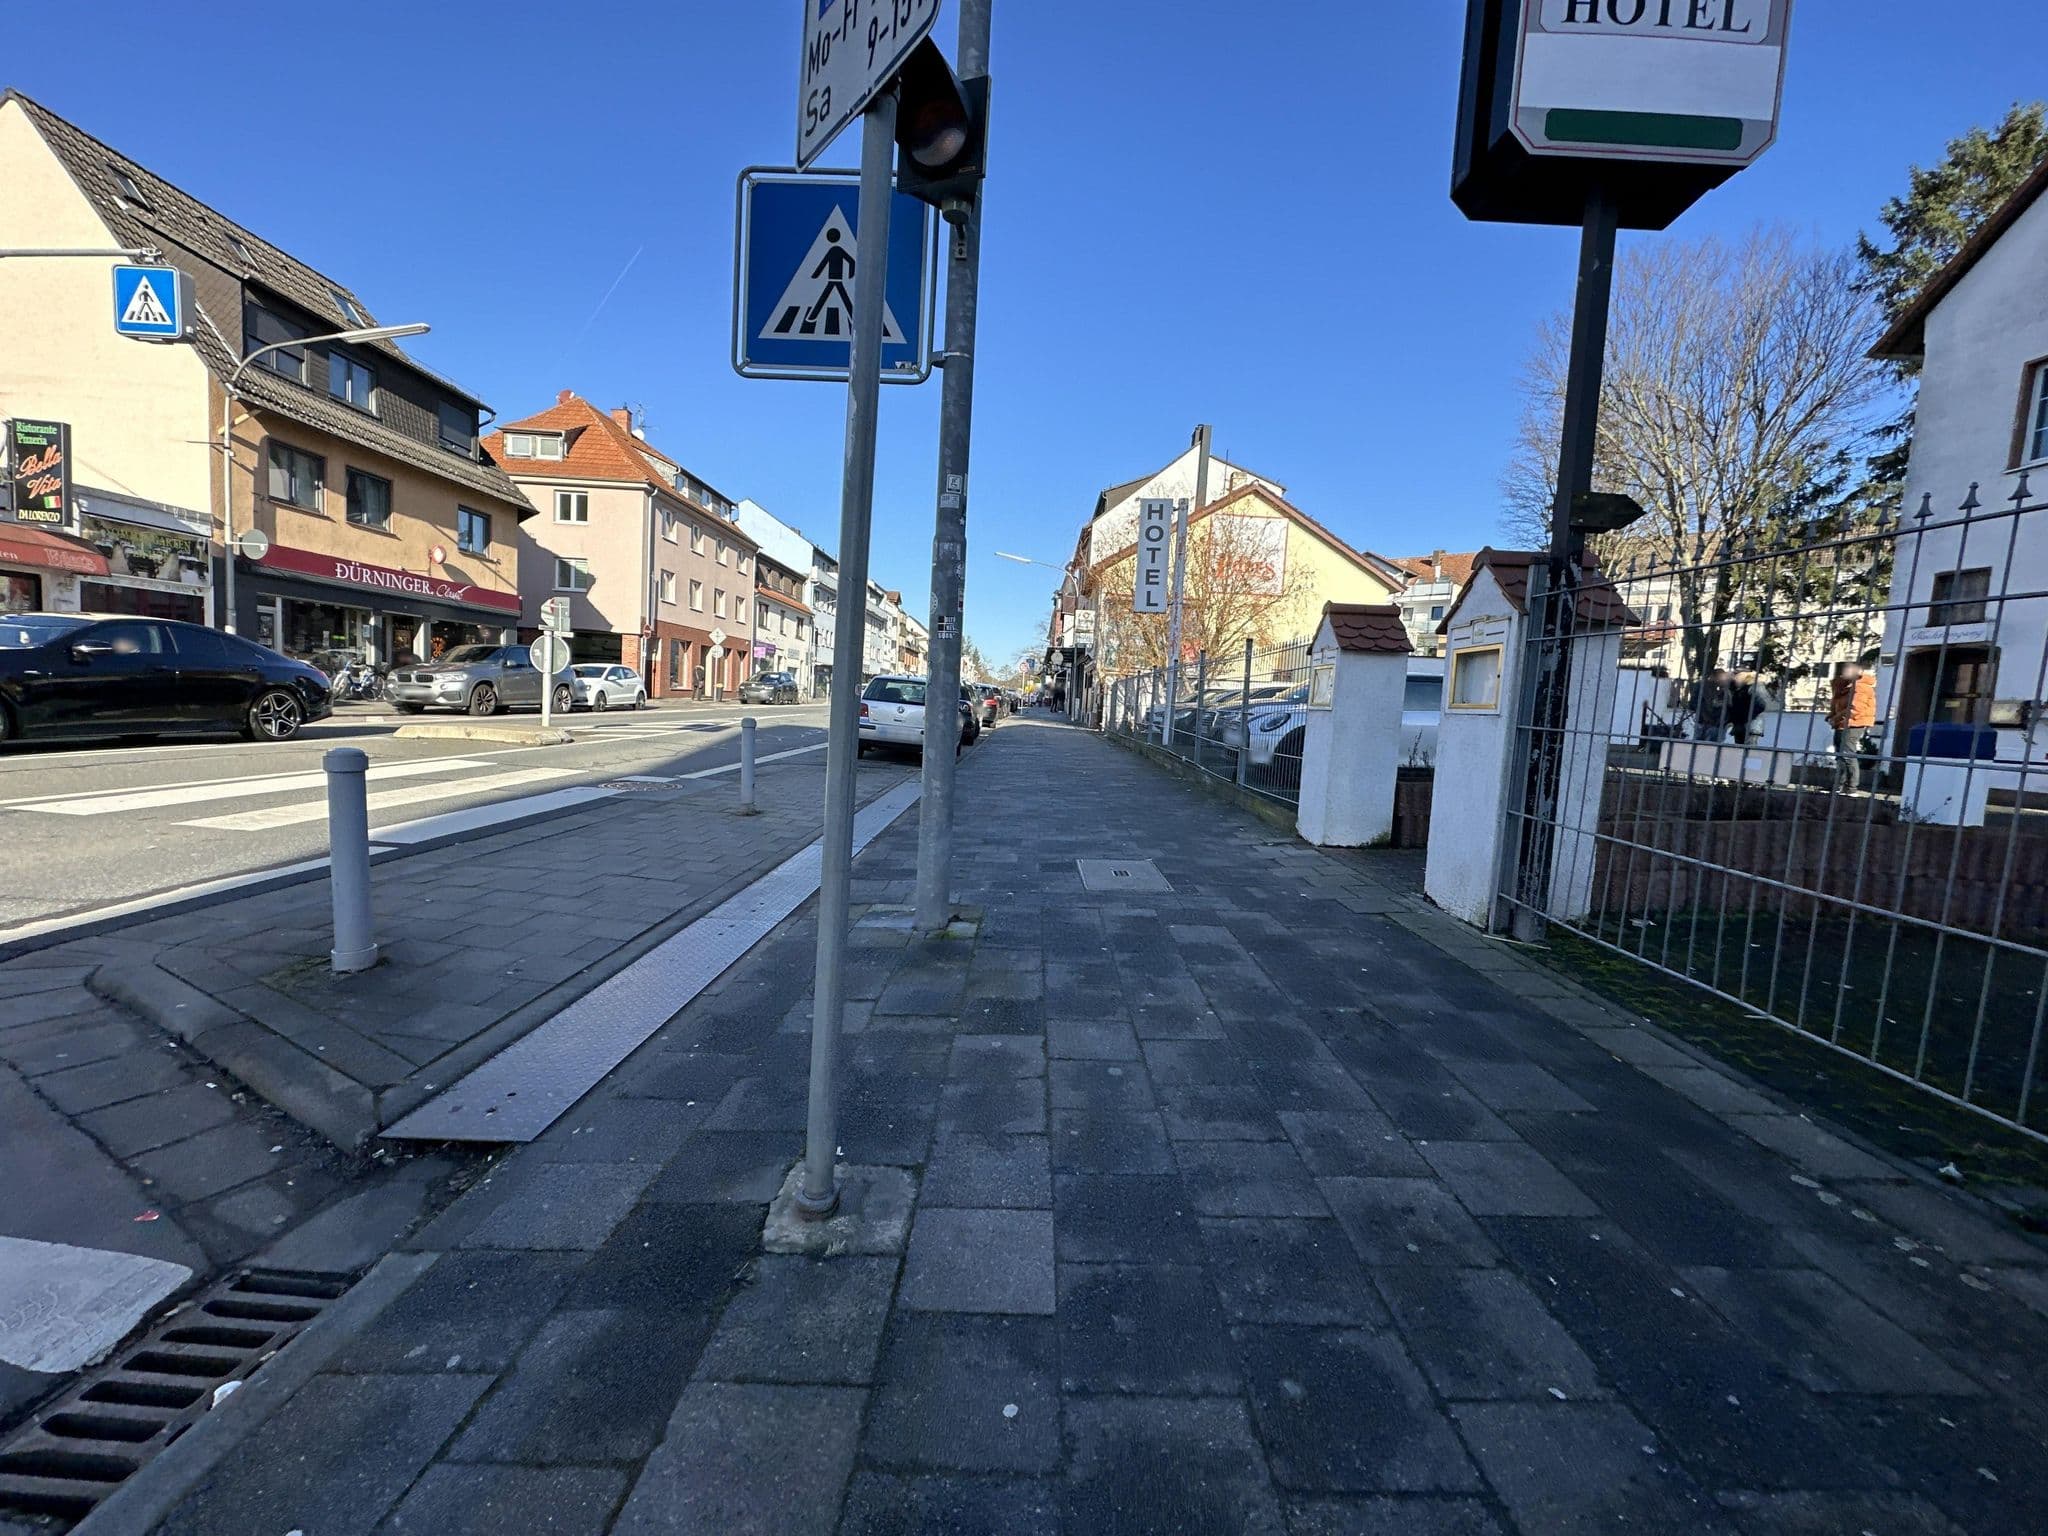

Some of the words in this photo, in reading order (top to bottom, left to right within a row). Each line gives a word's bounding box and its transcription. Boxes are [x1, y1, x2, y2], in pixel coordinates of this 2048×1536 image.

[1561, 0, 1751, 33] HOTEL
[805, 86, 831, 137] Sa
[15, 421, 58, 435] Ristorante
[15, 444, 63, 480] Bella
[26, 473, 62, 499] Vita
[29, 509, 60, 522] LORENZO
[1144, 503, 1165, 608] HOTEL
